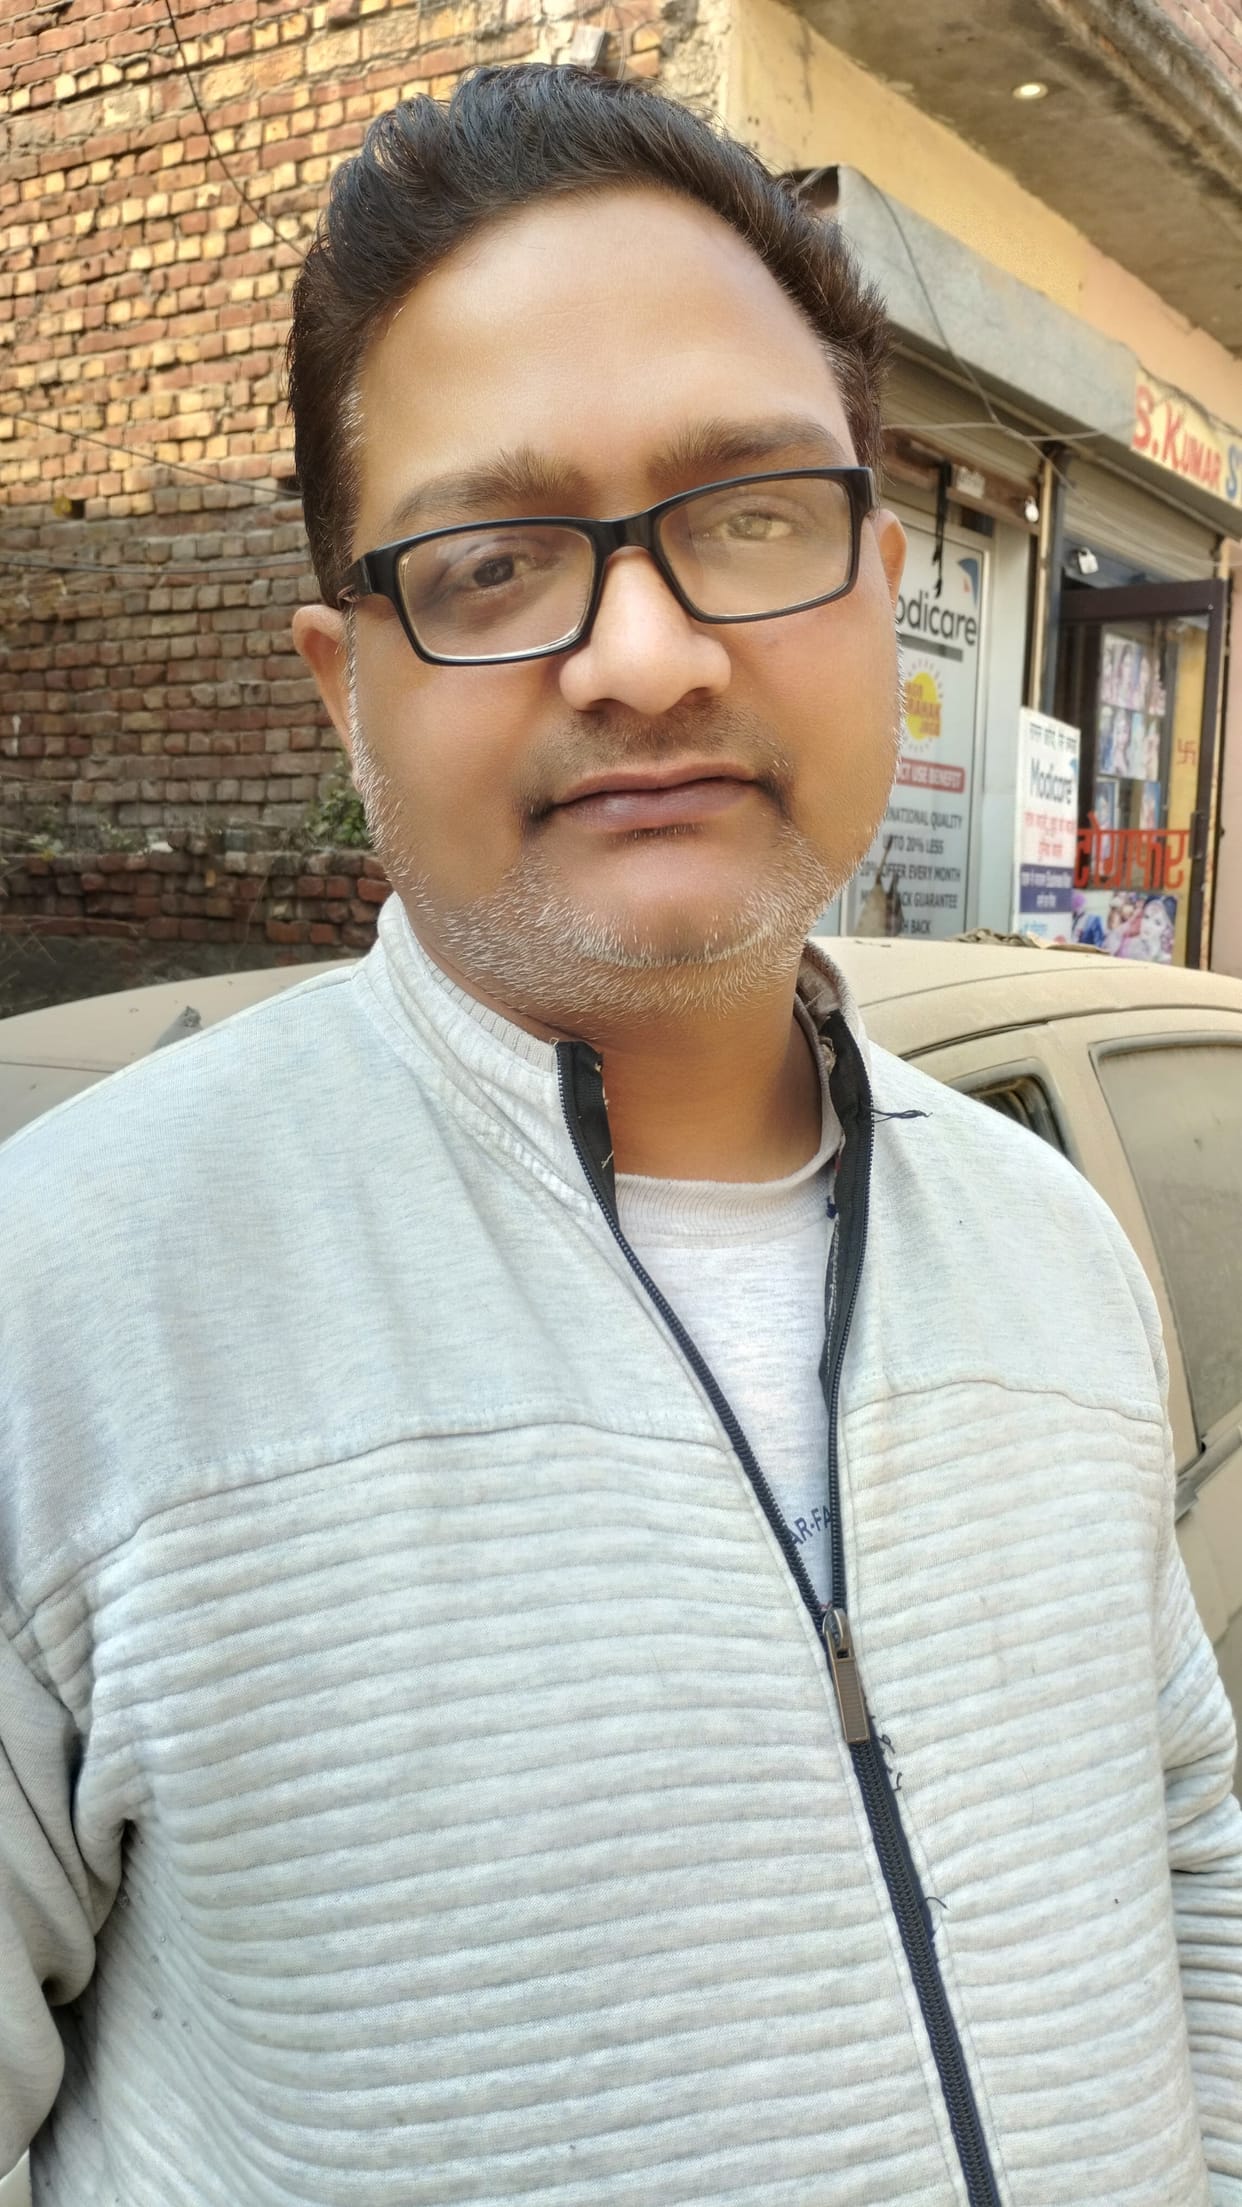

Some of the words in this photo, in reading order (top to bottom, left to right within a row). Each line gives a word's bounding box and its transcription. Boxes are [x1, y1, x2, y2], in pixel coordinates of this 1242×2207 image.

[896, 589, 977, 647] odicare
[1030, 757, 1072, 805] Modicare
[888, 807, 928, 826] NATIONAL
[931, 811, 963, 830] QUALITY
[926, 838, 944, 855] LESS
[909, 864, 933, 881] EVERY
[934, 866, 961, 882] MONTH
[914, 892, 958, 909] GUARANTEE
[911, 919, 932, 935] BACK
